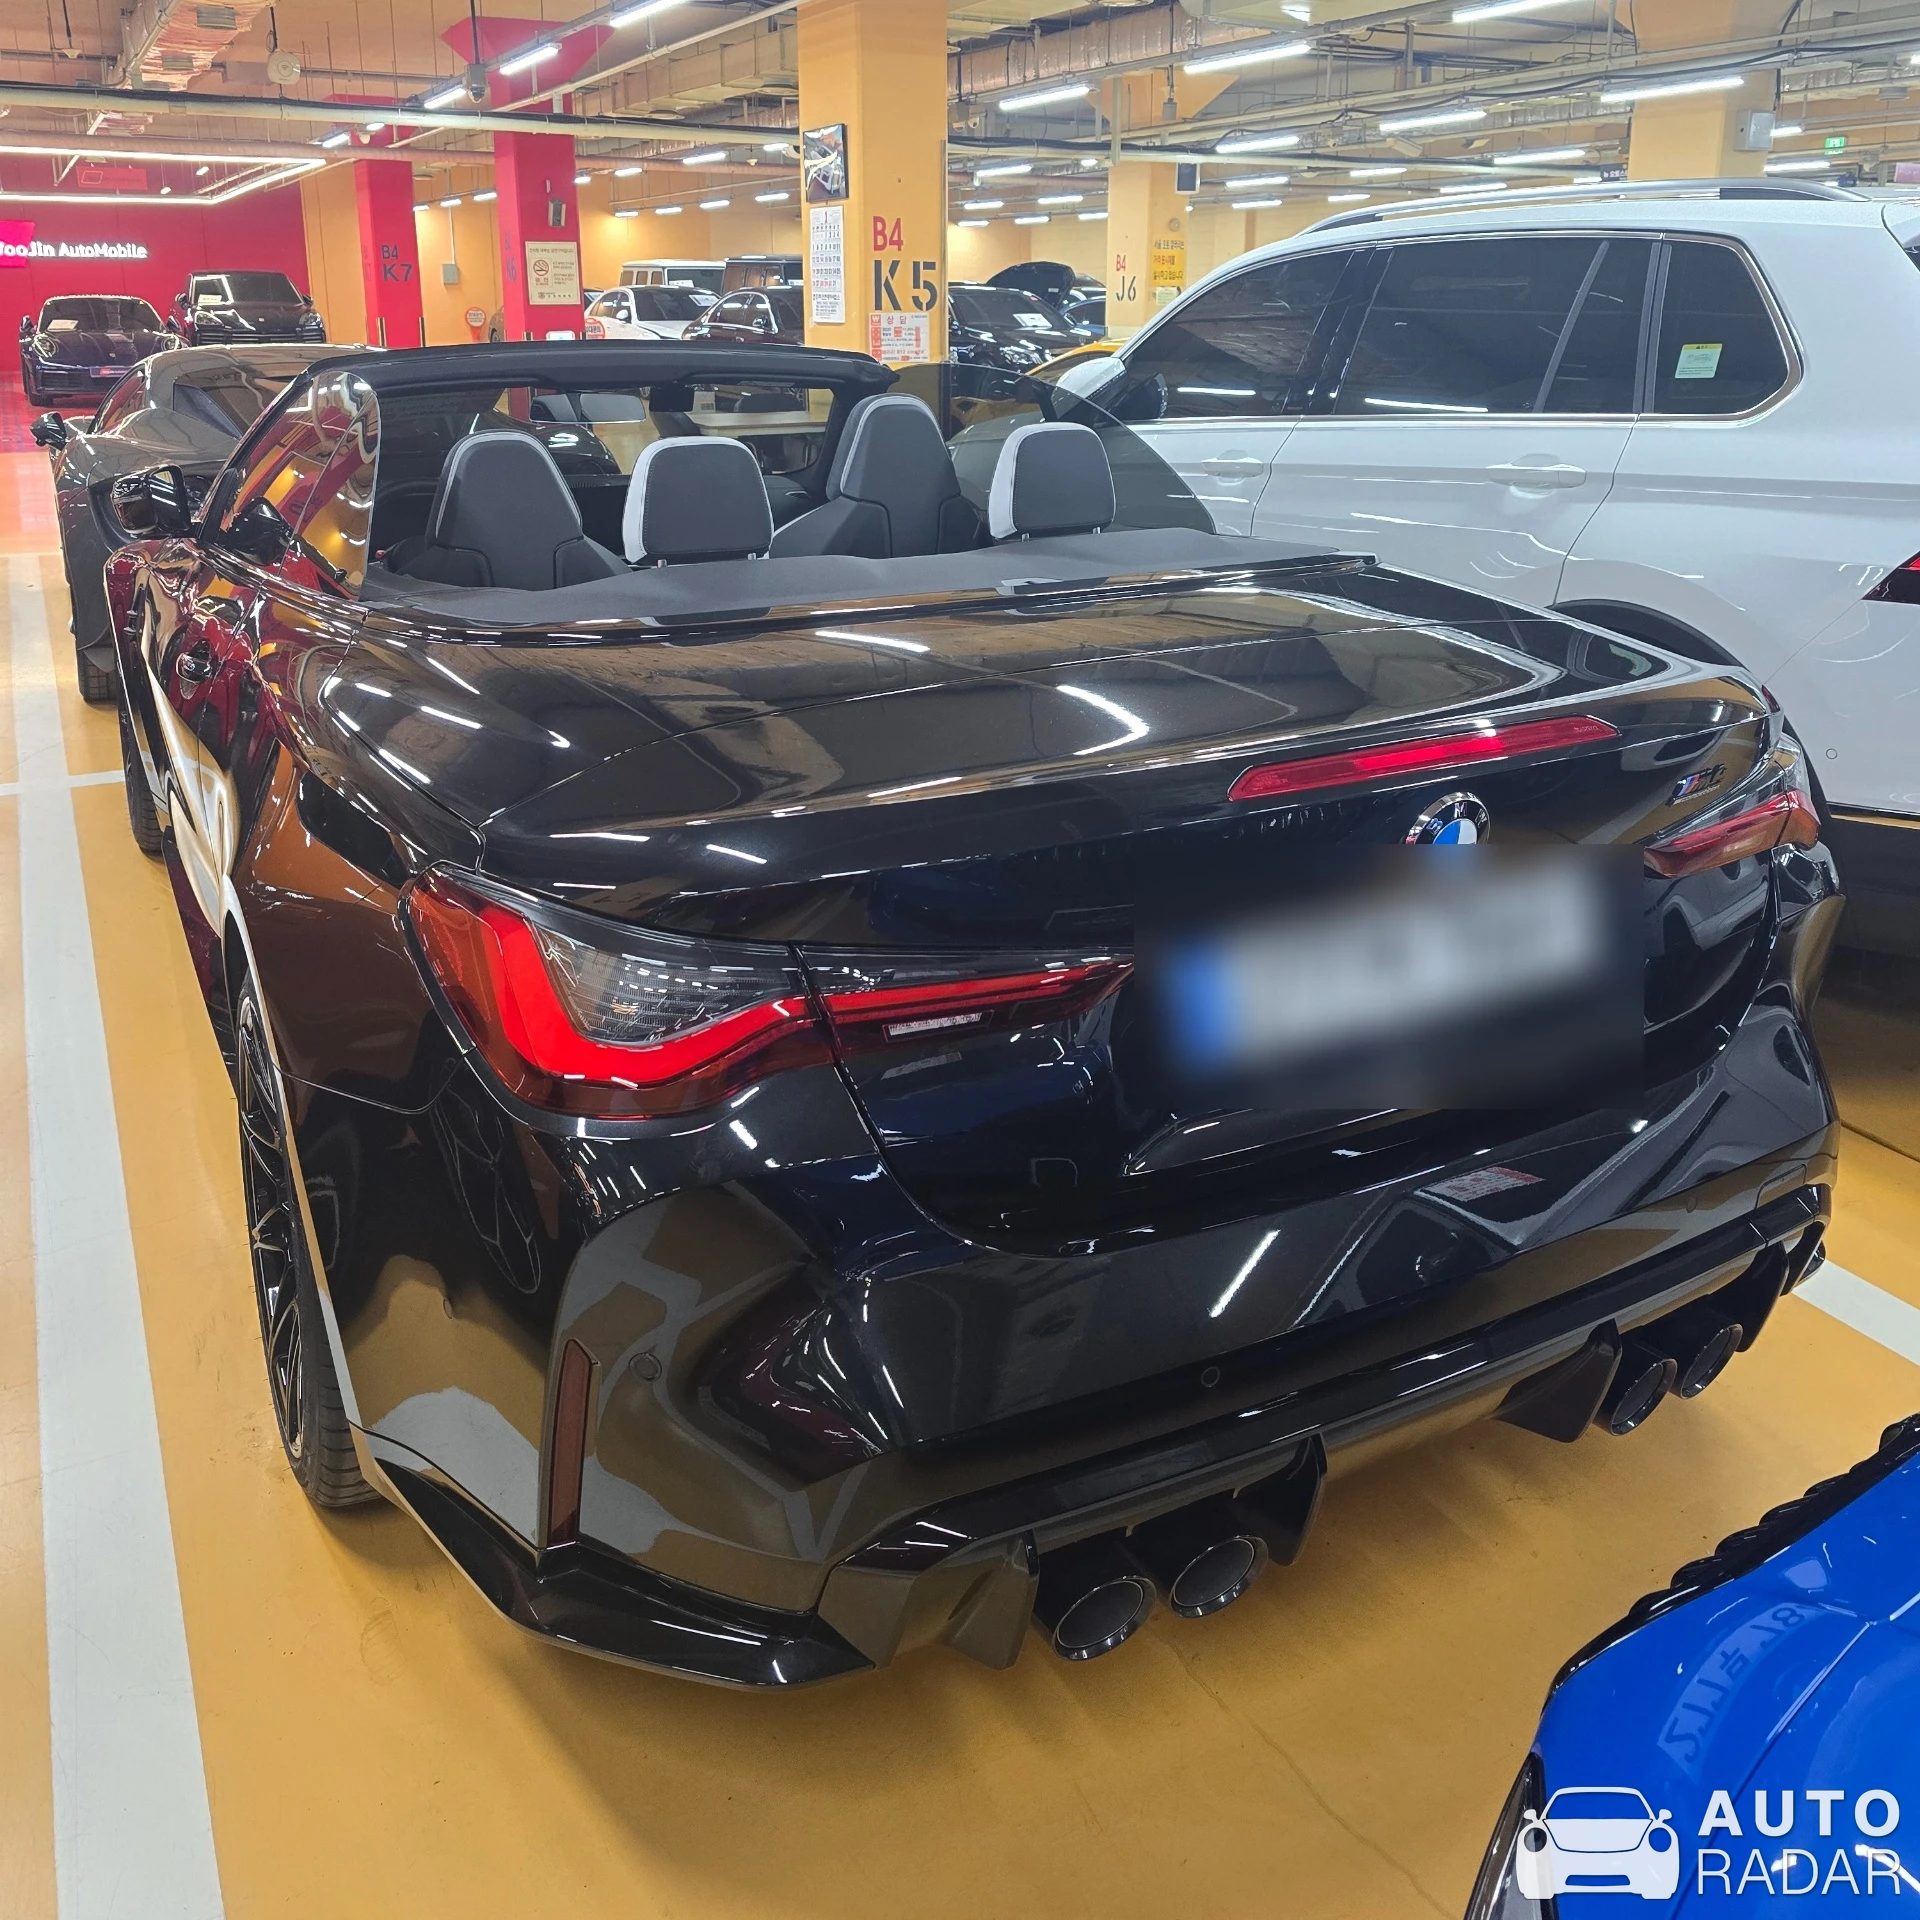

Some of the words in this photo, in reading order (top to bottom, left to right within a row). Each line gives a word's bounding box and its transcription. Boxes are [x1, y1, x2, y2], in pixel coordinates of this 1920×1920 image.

[873, 215, 904, 251] B4
[58, 242, 148, 259] AutoMobile
[381, 244, 400, 260] B4
[1116, 254, 1126, 272] B4
[1115, 275, 1137, 302] J6
[1425, 801, 1488, 836] BMW
